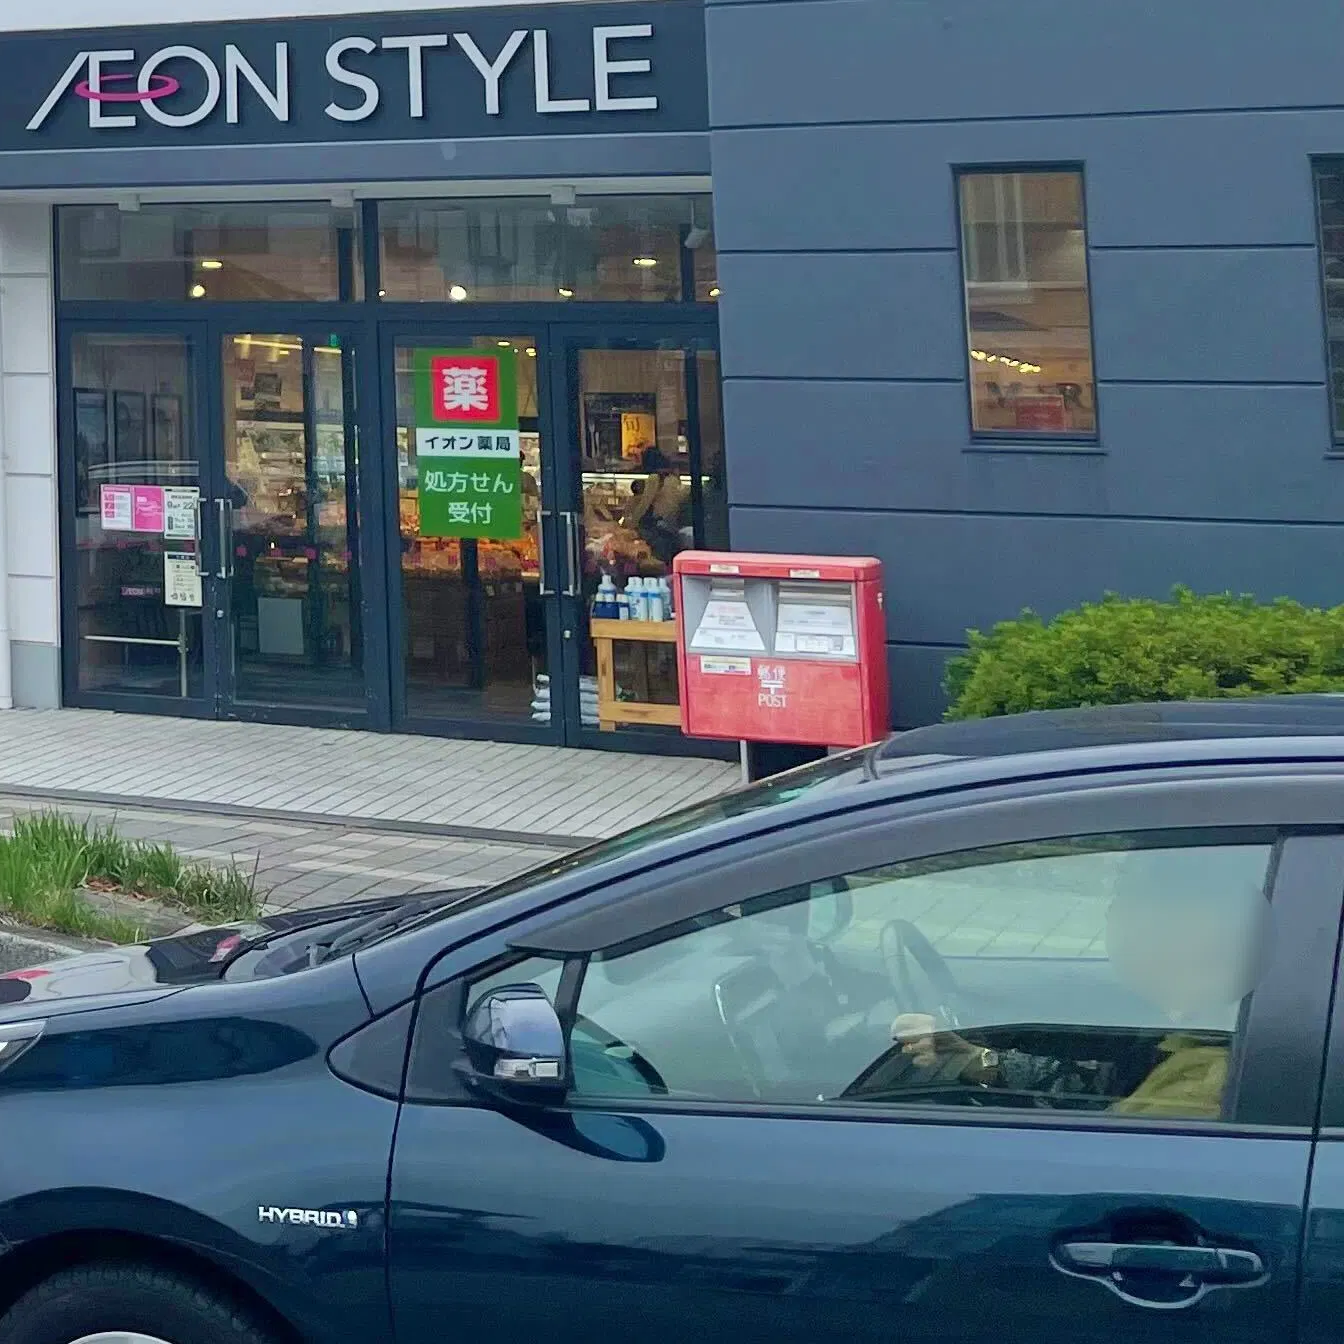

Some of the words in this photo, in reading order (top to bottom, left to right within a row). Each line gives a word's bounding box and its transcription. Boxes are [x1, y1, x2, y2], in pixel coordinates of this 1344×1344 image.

[25, 42, 289, 130] AEON
[323, 24, 658, 122] STYLE
[441, 366, 489, 411] 薬
[424, 434, 512, 452] イオン薬局
[424, 470, 513, 494] 処方せん
[447, 501, 494, 525] 受付
[757, 693, 786, 708] POST
[258, 1206, 342, 1228] HYBRID
